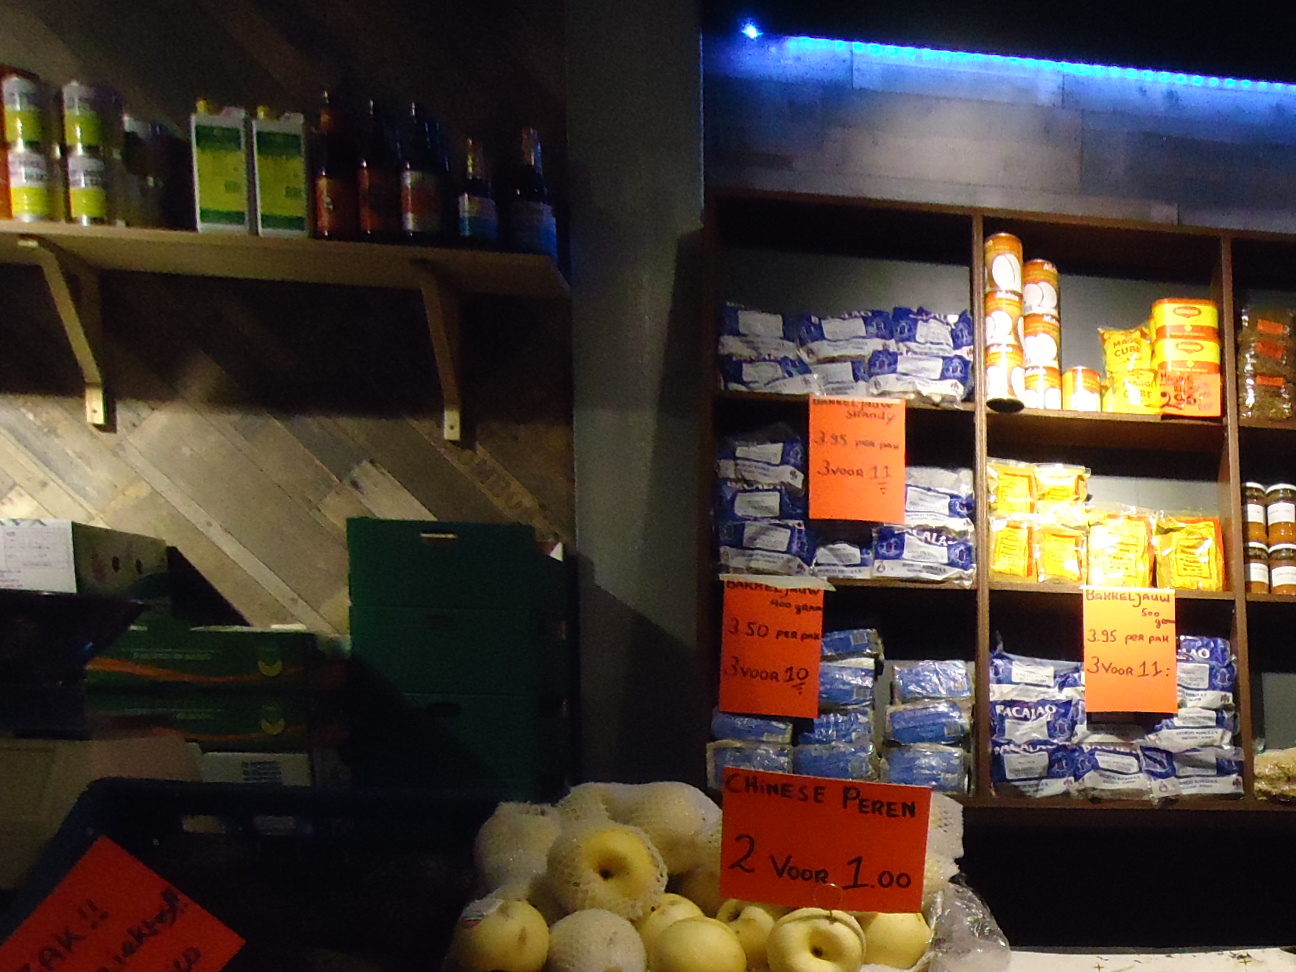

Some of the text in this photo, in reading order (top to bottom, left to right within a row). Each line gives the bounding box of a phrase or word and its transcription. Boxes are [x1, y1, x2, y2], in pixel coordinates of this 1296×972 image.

[1086, 627, 1118, 643] 3.95
[724, 772, 918, 819] CHINESE PEREN
[727, 833, 756, 874] 2
[841, 855, 913, 891] 1.00
